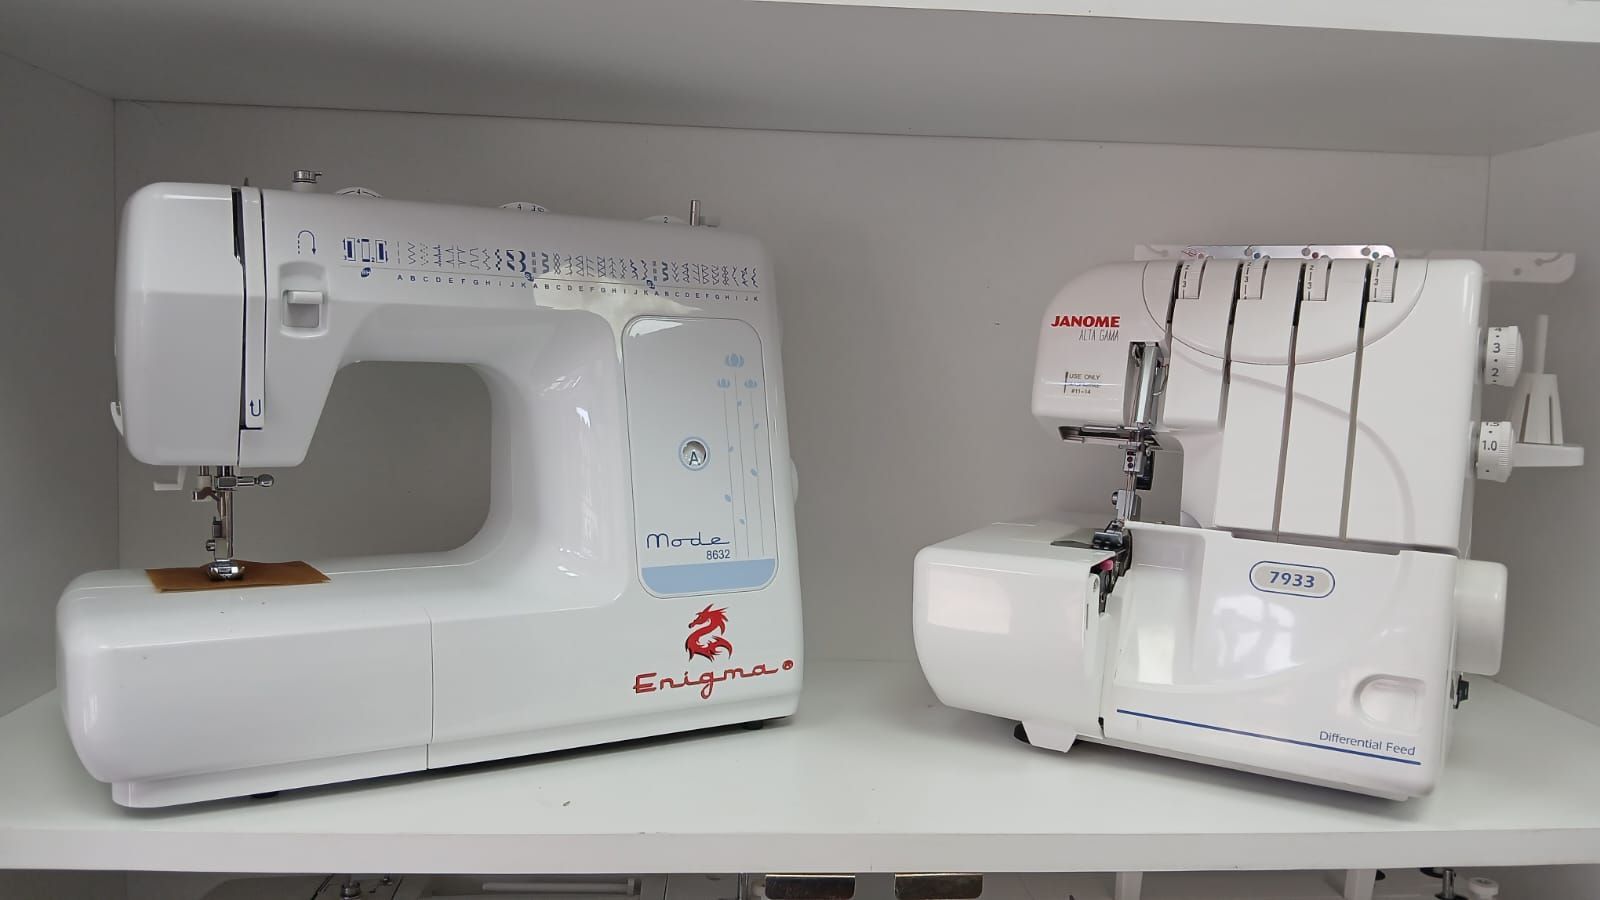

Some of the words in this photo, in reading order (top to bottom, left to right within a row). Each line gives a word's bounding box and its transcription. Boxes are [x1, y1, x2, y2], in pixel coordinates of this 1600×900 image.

[663, 216, 669, 224] 2
[1051, 315, 1120, 328] JANOME
[1079, 329, 1096, 341] ALTA
[1100, 329, 1119, 342] GAMA
[1492, 342, 1501, 354] 3
[1491, 367, 1499, 376] 2
[1482, 440, 1497, 451] 1.0
[689, 451, 701, 466] A
[647, 531, 730, 549] Mode
[706, 550, 731, 561] 8632
[1269, 571, 1315, 588] 7933
[632, 662, 779, 700] Enigma
[1319, 731, 1382, 751] Differential
[1385, 741, 1416, 757] Feed
